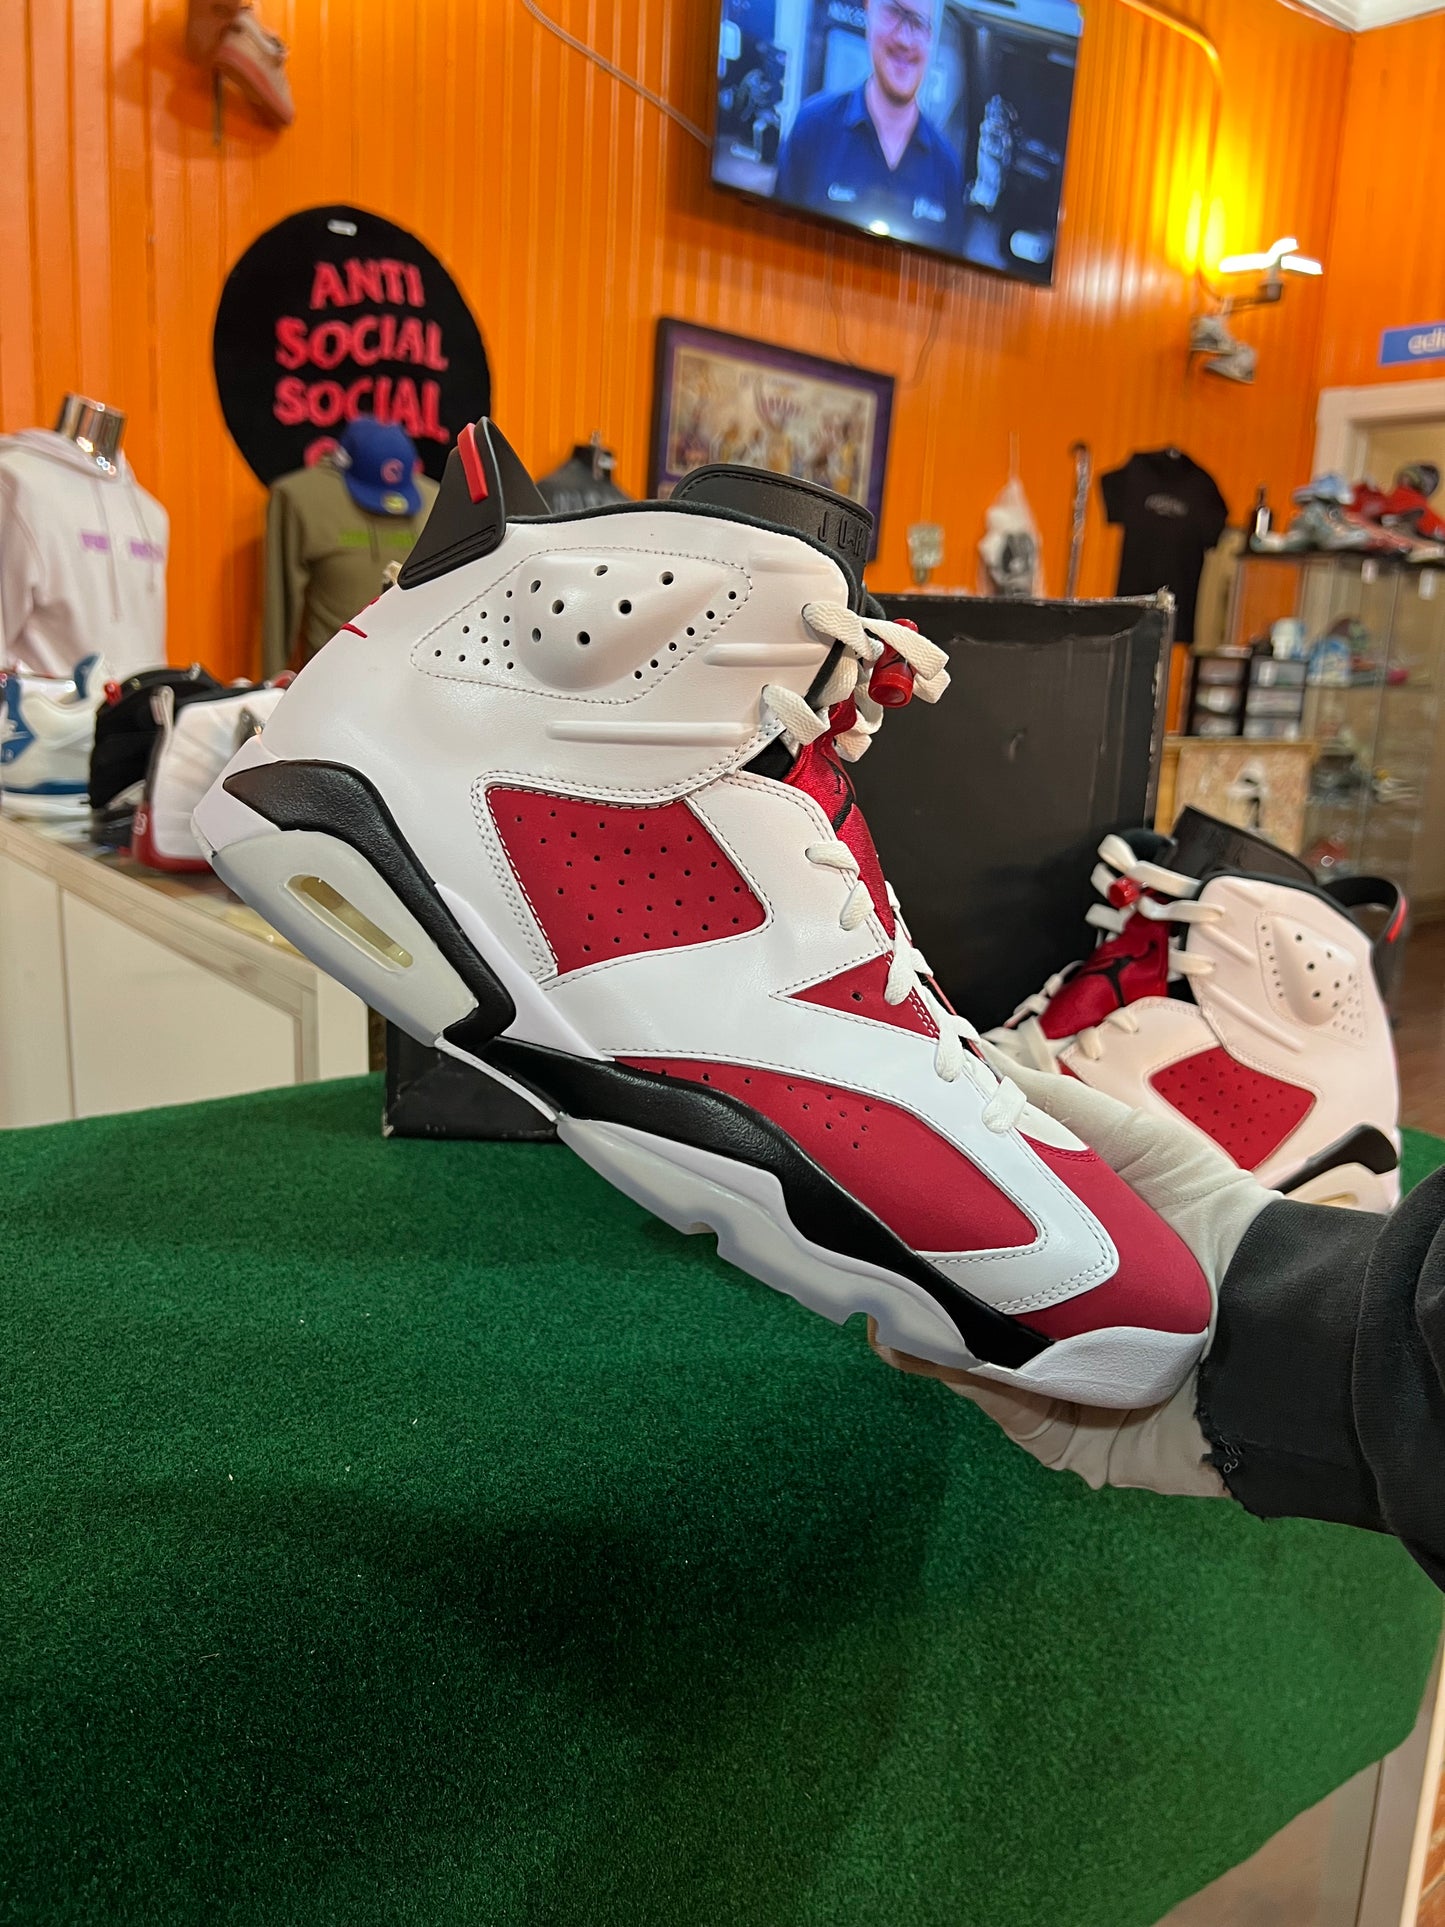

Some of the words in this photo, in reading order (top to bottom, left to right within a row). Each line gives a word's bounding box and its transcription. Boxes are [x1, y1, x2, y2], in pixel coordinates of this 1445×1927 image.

[310, 257, 425, 310] ANTI
[275, 314, 449, 371] SOCIAL
[273, 376, 449, 444] SOCIAL
